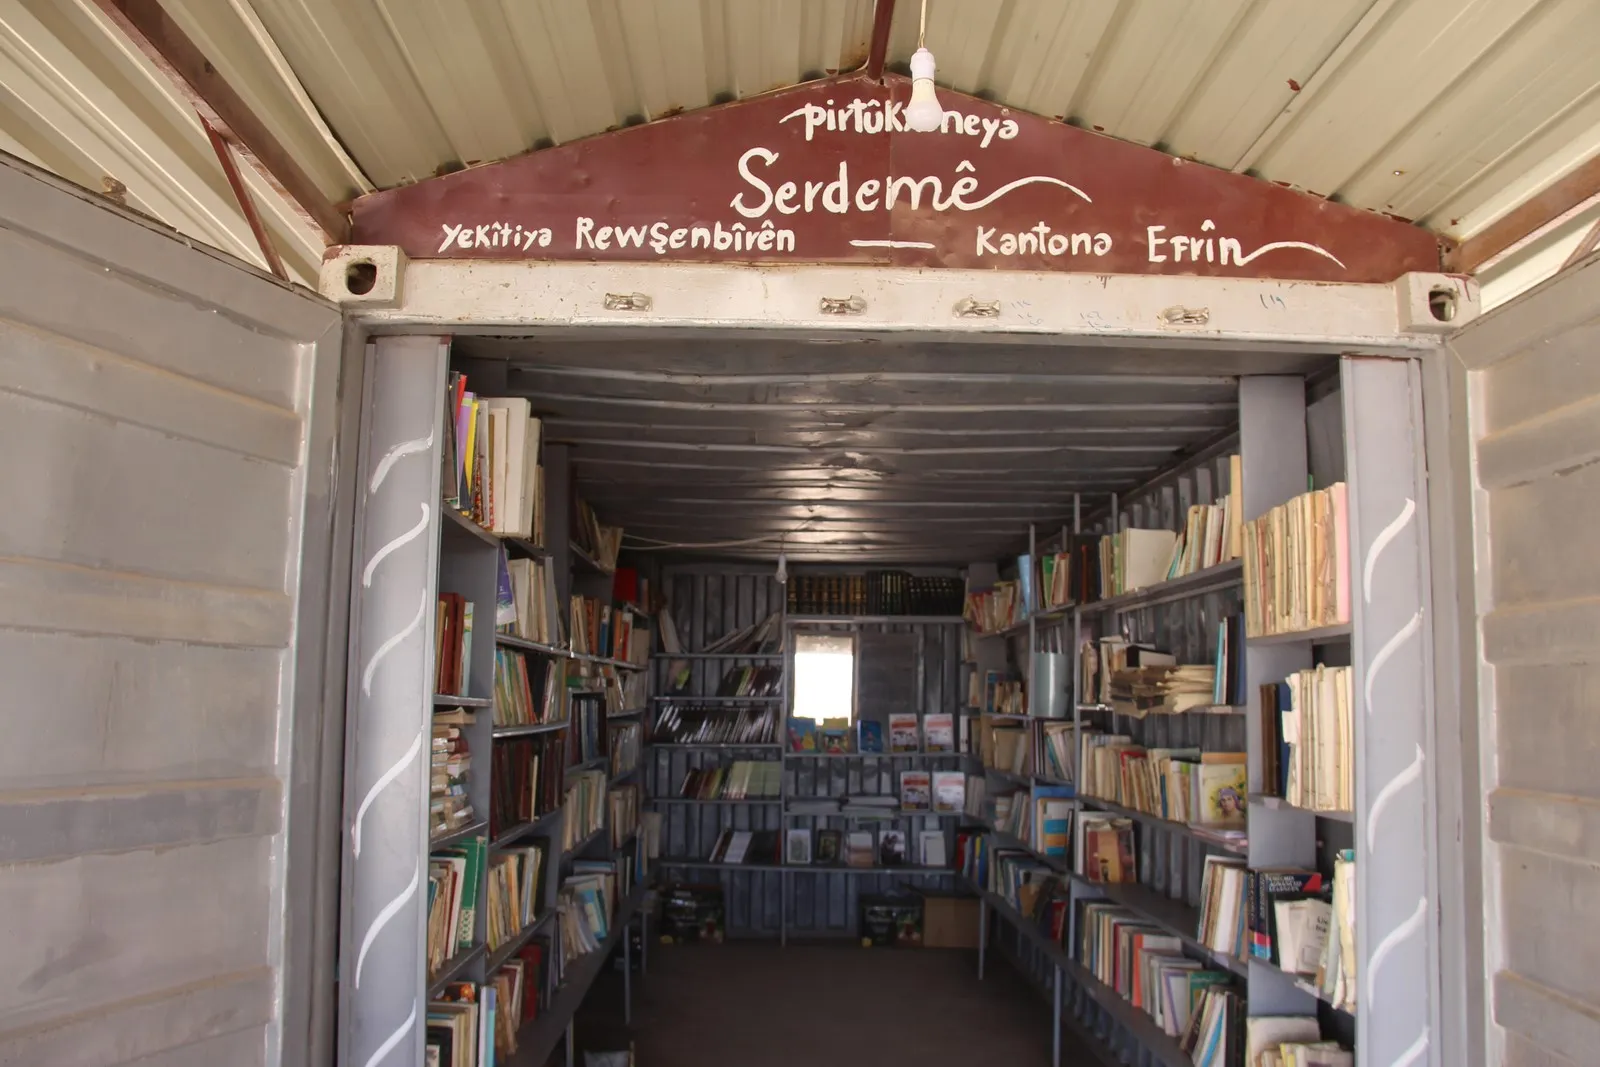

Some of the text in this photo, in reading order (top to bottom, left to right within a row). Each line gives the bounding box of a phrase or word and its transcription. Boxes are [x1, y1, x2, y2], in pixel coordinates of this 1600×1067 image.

[779, 99, 1019, 148] pirtûkneya
[729, 147, 1092, 219] Serdemê
[575, 216, 796, 255] Rewşenbîrên
